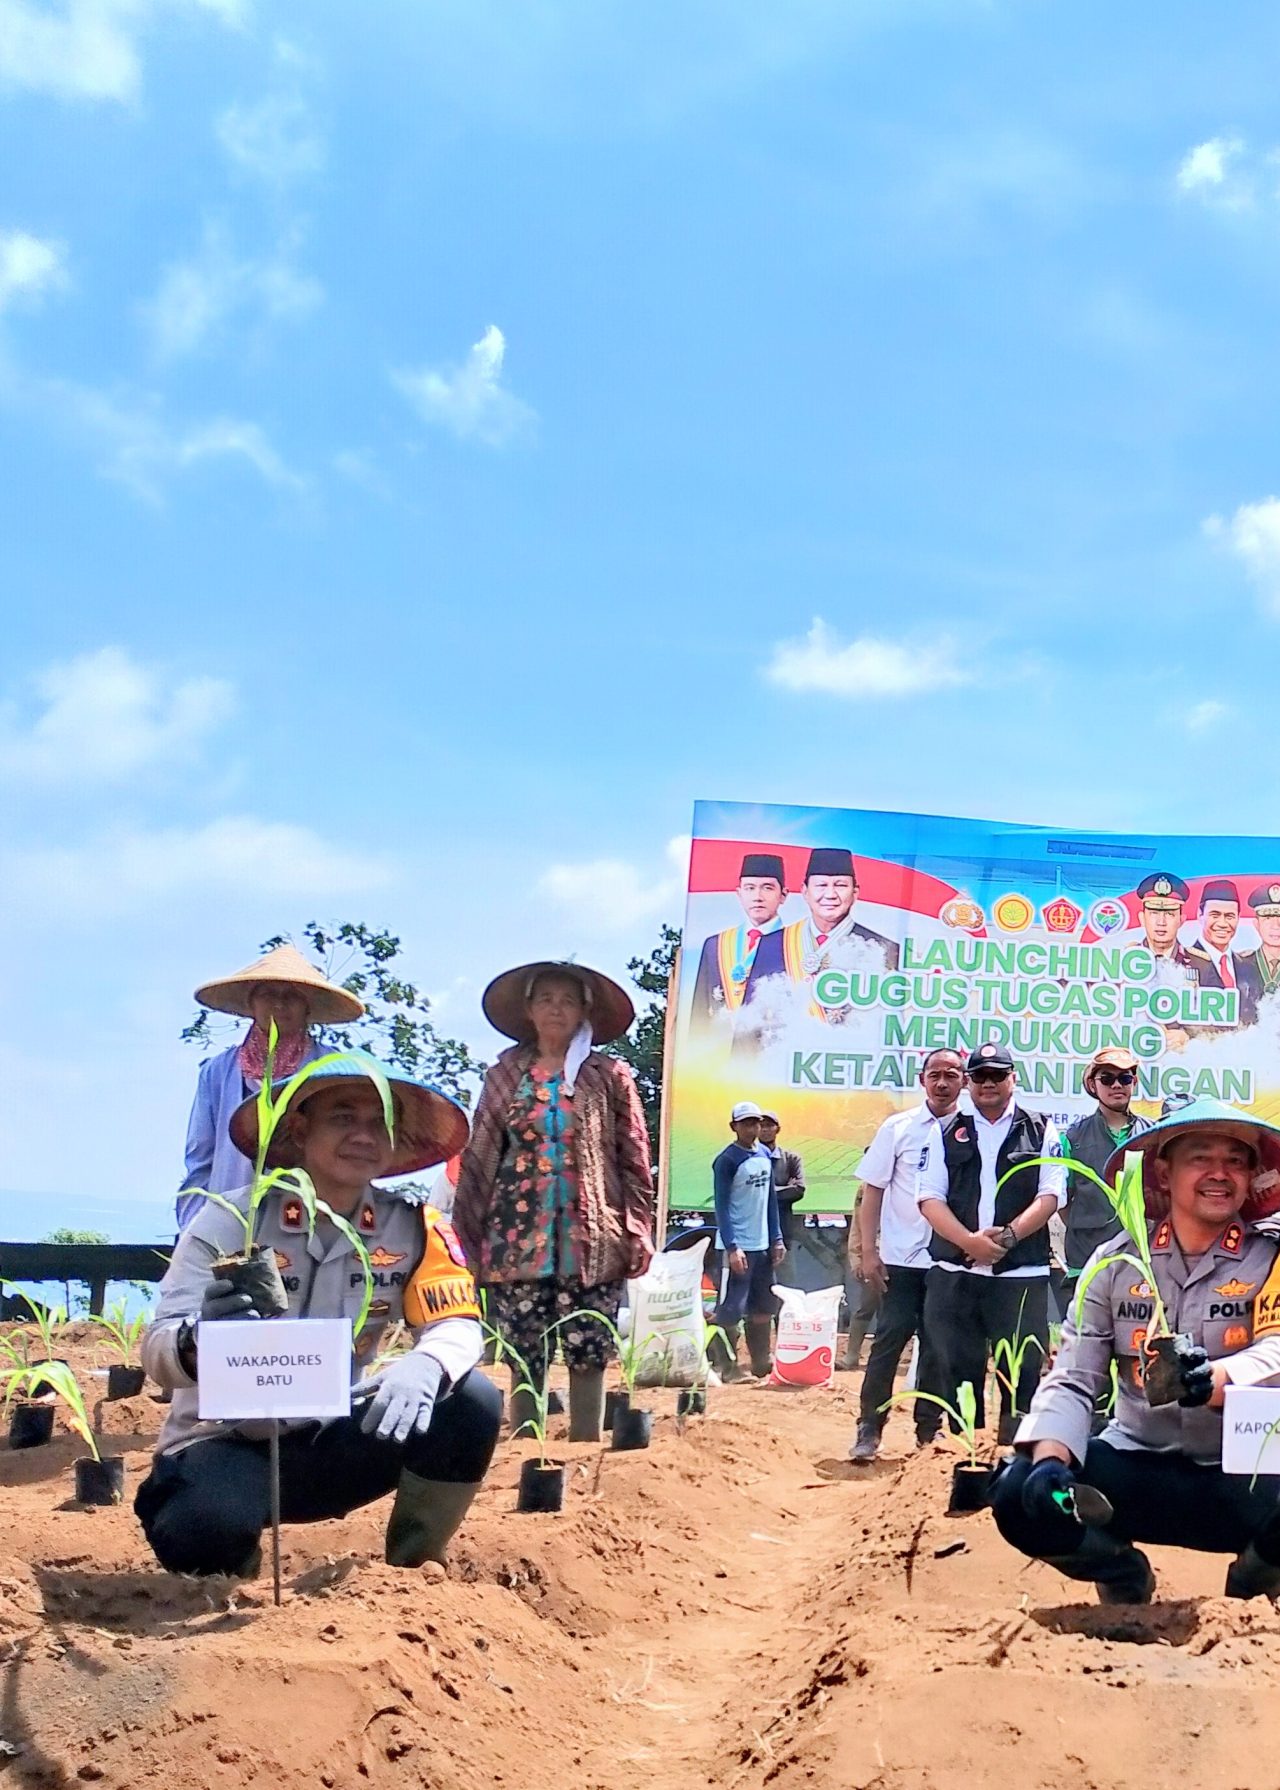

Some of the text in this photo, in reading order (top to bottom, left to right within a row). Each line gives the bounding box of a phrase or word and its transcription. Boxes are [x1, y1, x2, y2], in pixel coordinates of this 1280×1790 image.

[904, 937, 1153, 981] LAUNCHING
[816, 972, 1236, 1023] GUGUS TUGAS POLRI
[884, 1014, 1163, 1058] MENDUKUNG
[791, 1051, 1064, 1094] KETAHAN
[226, 1354, 322, 1368] WAKAPOLRES
[256, 1375, 293, 1387] BATU
